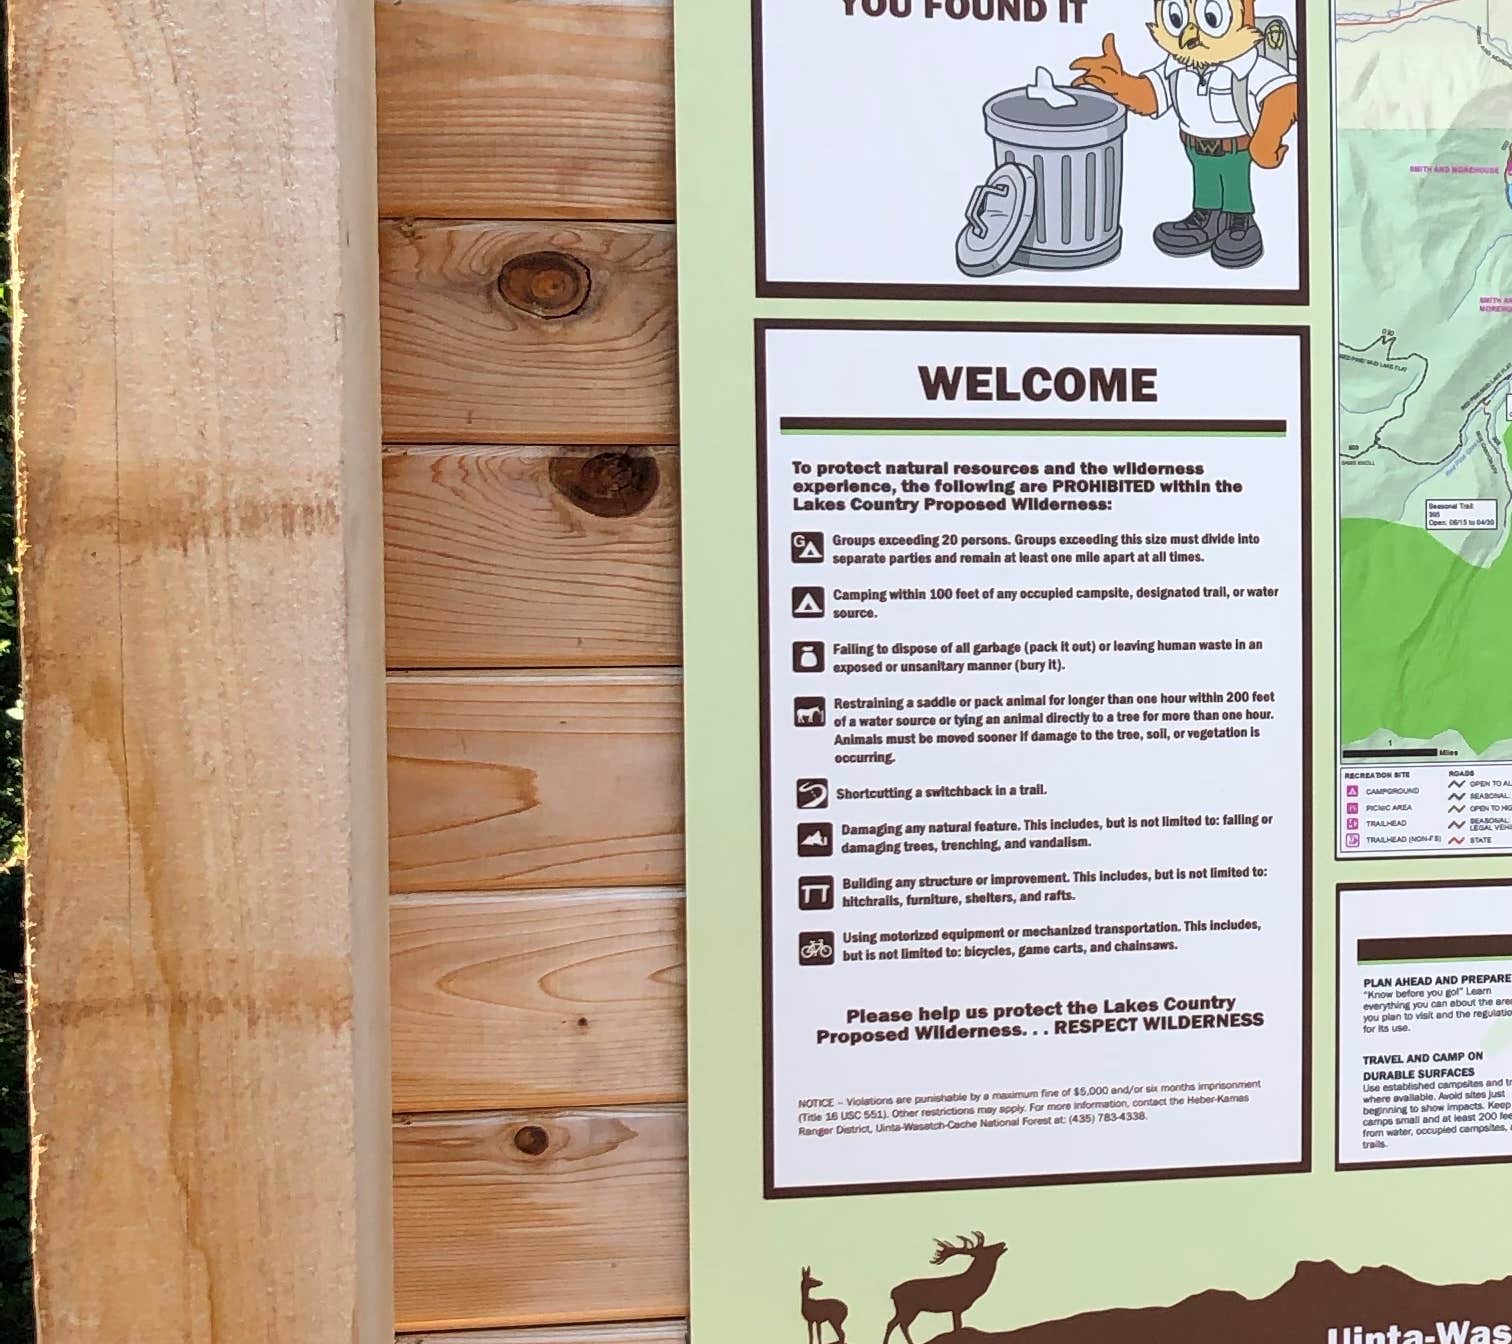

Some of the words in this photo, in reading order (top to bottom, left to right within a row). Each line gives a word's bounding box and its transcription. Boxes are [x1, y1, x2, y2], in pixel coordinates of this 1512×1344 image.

[917, 365, 1158, 402] WELCOME
[791, 460, 812, 474] To
[816, 460, 882, 477] protect
[885, 460, 949, 475] natural
[953, 463, 1039, 475] resources
[1043, 461, 1075, 475] and
[1079, 461, 1108, 475] the
[1112, 461, 1204, 475] wilderness
[792, 480, 897, 495] experience,
[899, 479, 930, 493] the
[933, 479, 1015, 495] following
[1018, 481, 1048, 493] are
[1052, 479, 1155, 493] PROHIBITED
[1159, 479, 1211, 493] within
[1214, 479, 1243, 493] the
[792, 497, 846, 511] Lakes
[849, 496, 920, 513] Country
[923, 497, 1006, 513] Proposed
[1010, 497, 1112, 511] Wilderness:
[831, 533, 876, 548] Groups
[877, 533, 940, 548] exceeding
[941, 533, 958, 545] 20
[960, 535, 1011, 547] persons.
[1013, 533, 1057, 547] Groups
[1058, 533, 1119, 547] exceeding
[1120, 533, 1143, 545] this
[1144, 533, 1167, 544] size
[1169, 533, 1199, 544] must
[1200, 532, 1235, 544] divide
[1237, 532, 1260, 544] into
[1344, 771, 1392, 779] RECREATION
[1393, 770, 1410, 778] SITE
[1365, 786, 1420, 795] CAMPGROUND
[1468, 779, 1491, 787] OPEN
[1491, 779, 1502, 787] TO
[835, 786, 913, 800] Shortcutting
[914, 788, 923, 798] a
[924, 785, 993, 797] switchback
[994, 784, 1007, 796] in
[1008, 786, 1017, 796] a
[1018, 783, 1047, 795] trail.
[1365, 819, 1407, 827] TRAILHEAD
[1469, 836, 1492, 844] STATE
[1363, 977, 1392, 988] PLAN
[1394, 976, 1433, 986] AHEAD
[1434, 974, 1458, 985] AND
[1460, 973, 1512, 984] PREPARE
[846, 1008, 913, 1023] Please
[918, 1005, 961, 1023] help
[965, 1007, 989, 1019] us
[993, 1001, 1063, 1021] protect
[1065, 1000, 1098, 1015] the
[1103, 998, 1159, 1013] Lakes
[1163, 995, 1236, 1011] Country
[816, 1026, 909, 1044] Proposed
[1053, 1016, 1138, 1034] RESPECT
[1142, 1012, 1264, 1030] WILDERNESS
[1362, 1054, 1404, 1065] TRAVEL
[1405, 1052, 1430, 1063] AND
[1431, 1051, 1465, 1062] CAMP
[1467, 1050, 1483, 1061] ON
[1362, 1069, 1415, 1081] DURABLE
[1417, 1067, 1475, 1078] SURFACES
